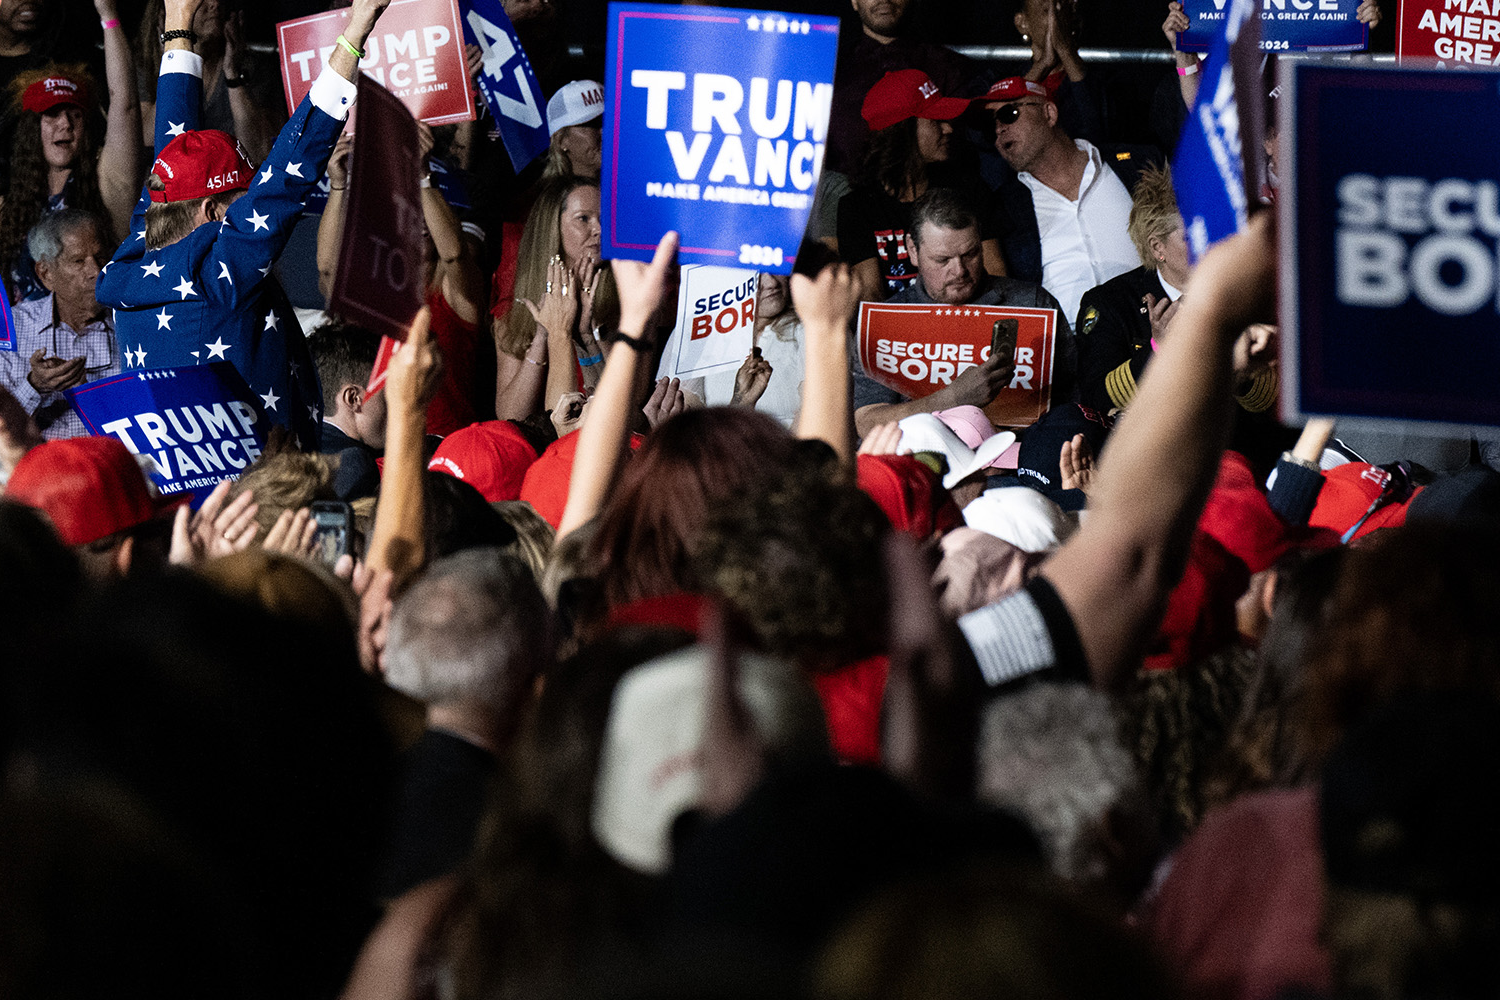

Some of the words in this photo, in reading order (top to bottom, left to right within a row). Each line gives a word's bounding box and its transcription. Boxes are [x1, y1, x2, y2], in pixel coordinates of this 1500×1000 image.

[1277, 12, 1310, 21] GREAT
[1312, 12, 1348, 21] AGAIN!
[1418, 9, 1500, 42] AMER
[1258, 40, 1290, 50] 2024
[1434, 37, 1500, 66] GRE
[467, 9, 543, 129] 47
[414, 83, 449, 96] AGAIN!
[631, 69, 834, 142] TRUM
[207, 171, 239, 189] 45/47
[1335, 173, 1500, 237] SECU
[694, 277, 755, 314] SECUR
[691, 298, 754, 341] BOR
[876, 339, 974, 361] SECURE
[876, 352, 1034, 390] BORR
[101, 401, 258, 455] TRUMP
[148, 438, 262, 480] VANCE
[184, 475, 222, 489] AMERICA
[1025, 468, 1051, 485] TRUMP
